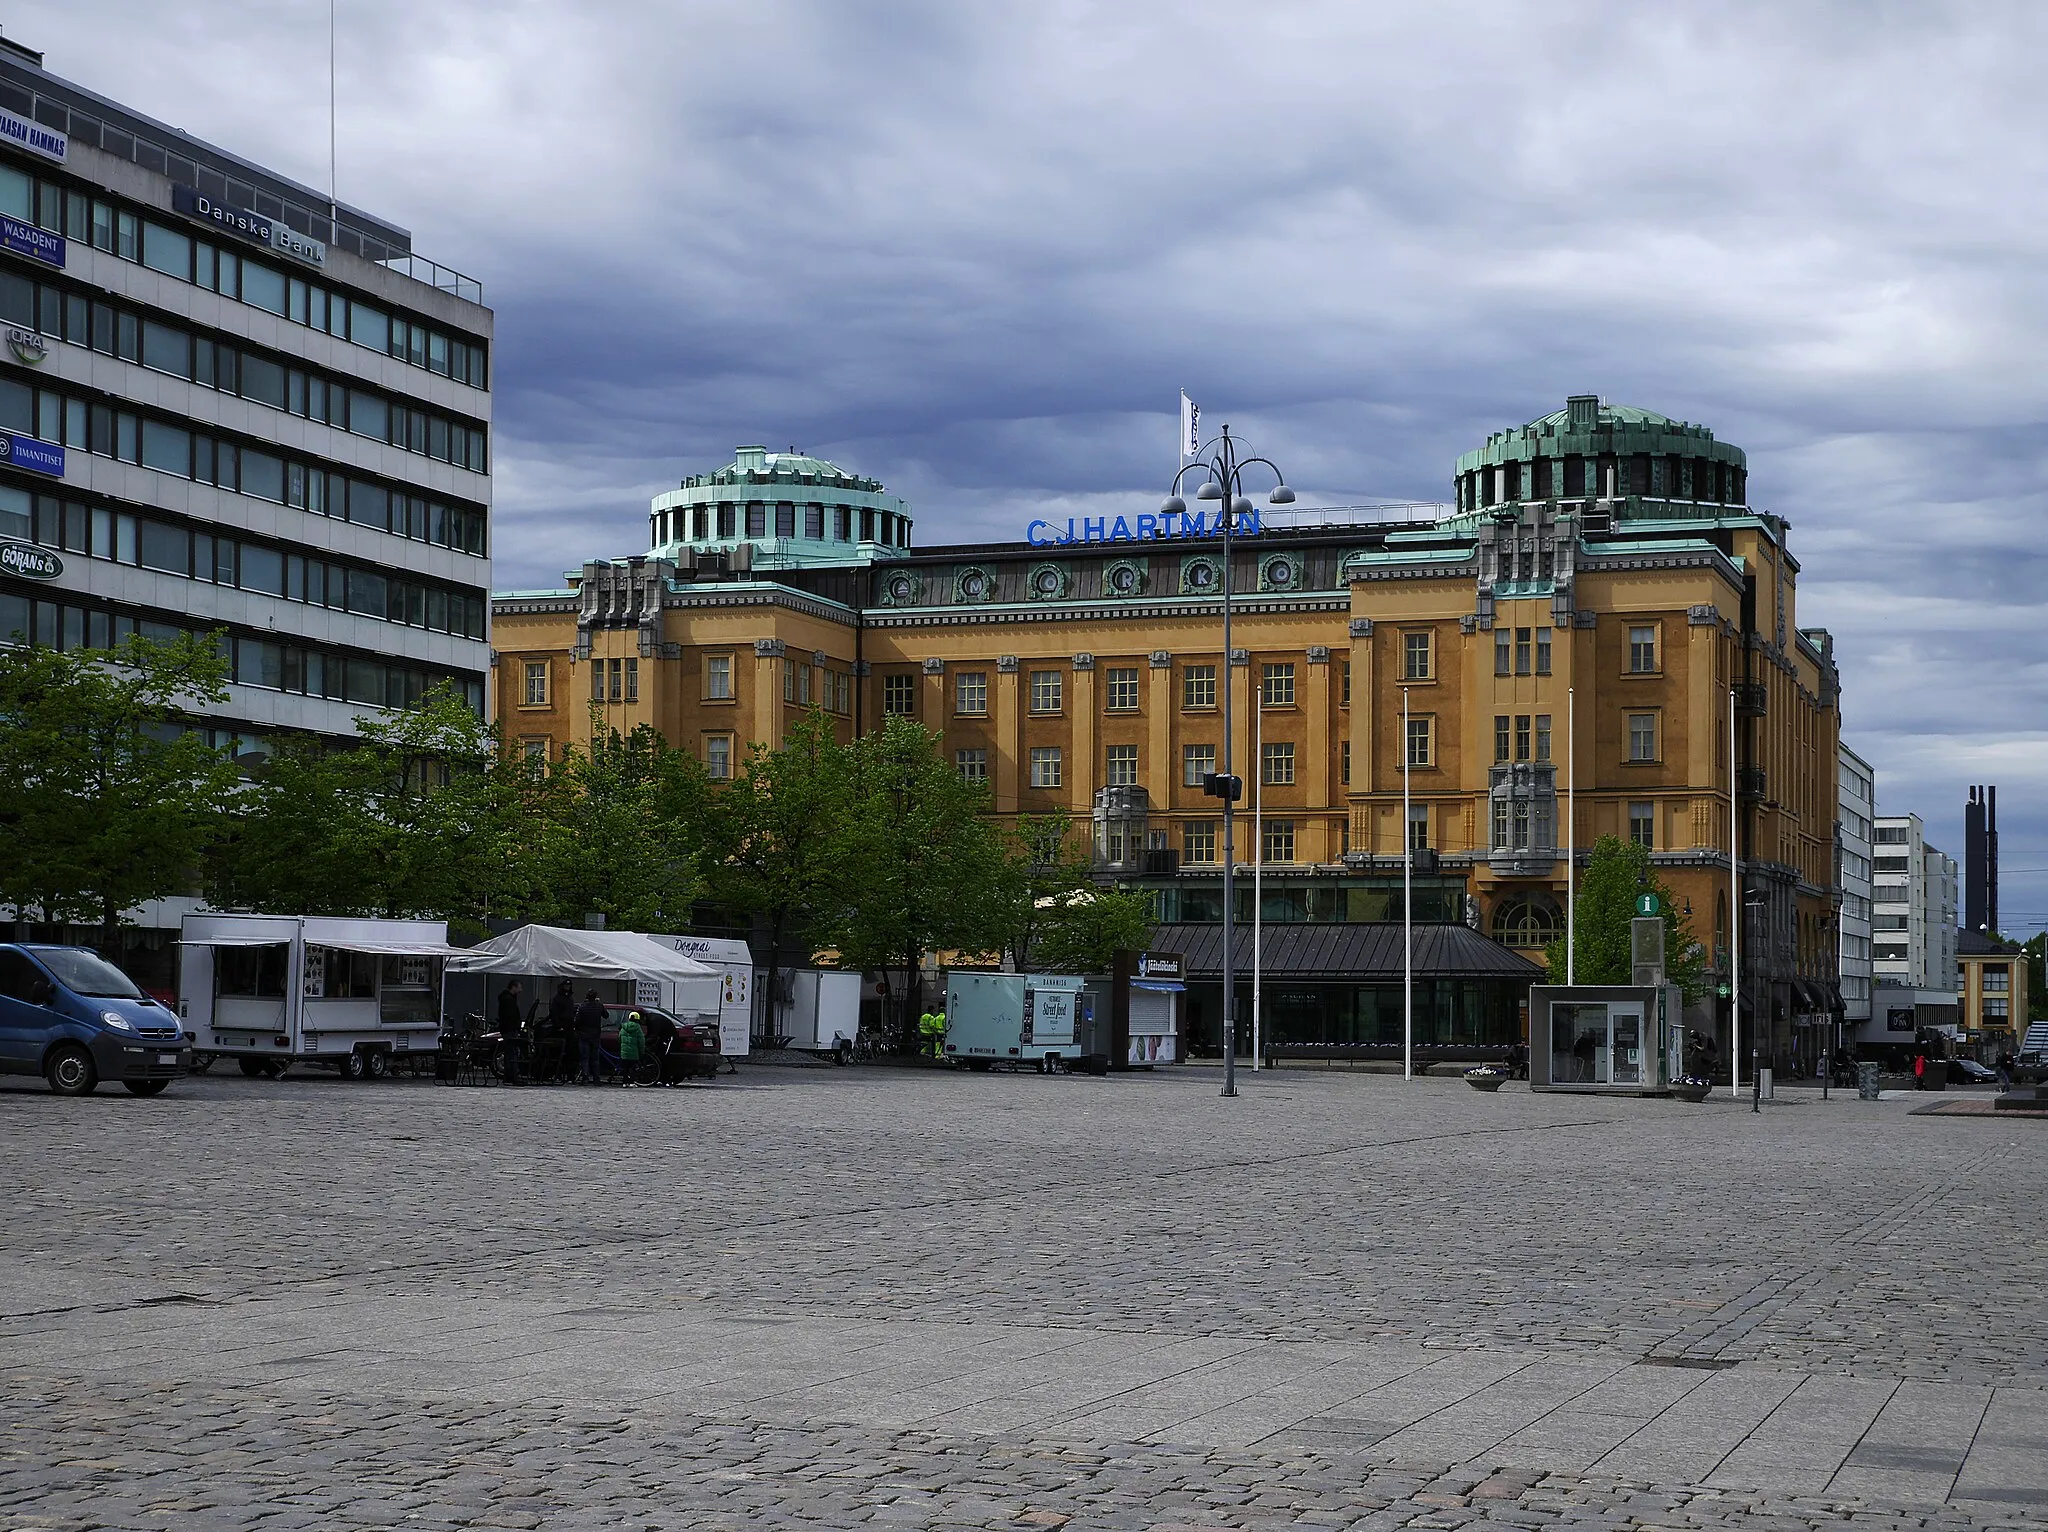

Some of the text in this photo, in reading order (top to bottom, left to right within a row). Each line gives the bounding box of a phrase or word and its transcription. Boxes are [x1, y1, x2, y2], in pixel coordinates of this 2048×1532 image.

[30, 128, 65, 156] HAMMAS
[3, 221, 58, 251] WASADENT
[197, 196, 323, 262] Danske Bank
[15, 445, 63, 467] TIMANTTISET
